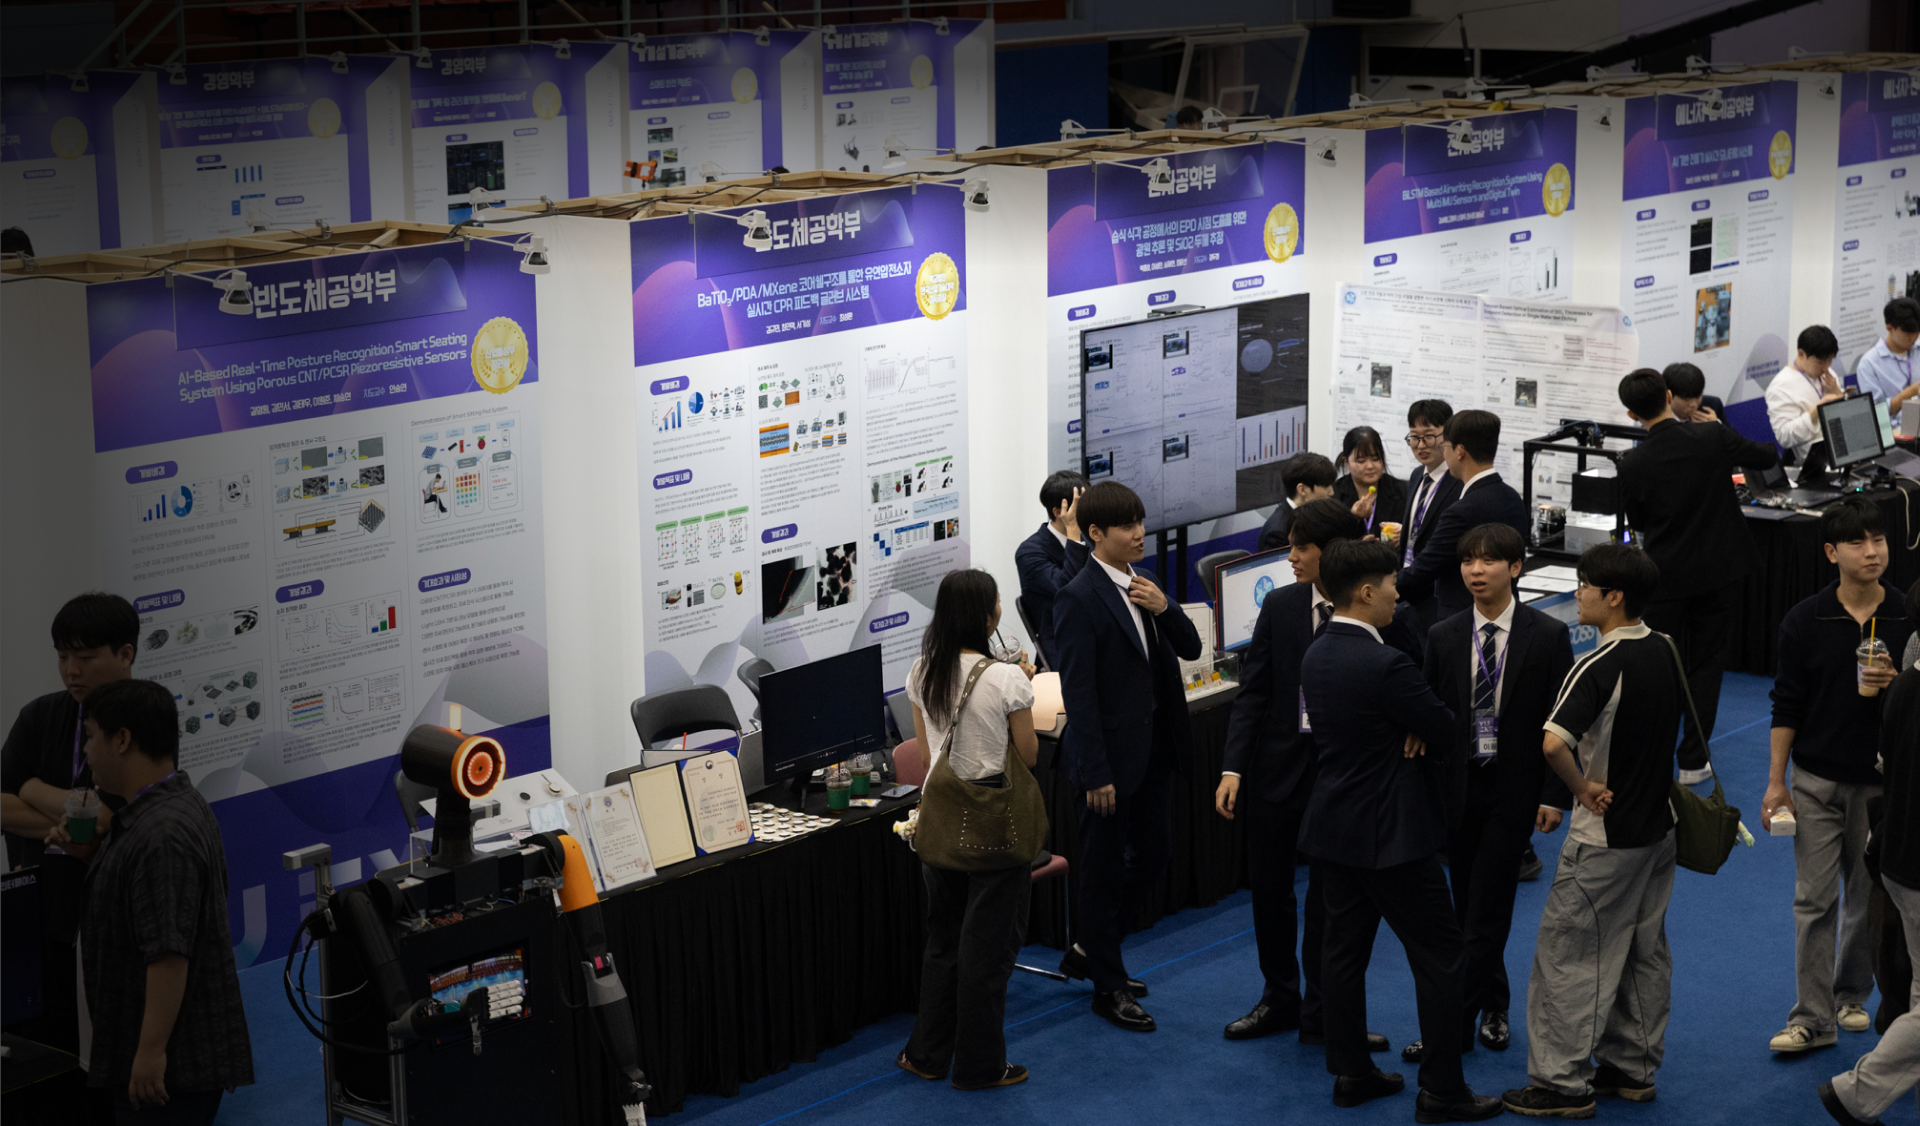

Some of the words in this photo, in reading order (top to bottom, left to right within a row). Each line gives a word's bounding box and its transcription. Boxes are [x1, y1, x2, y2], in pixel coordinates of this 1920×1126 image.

[441, 56, 486, 76] 경영학부
[203, 71, 255, 90] 경영학부
[650, 79, 665, 89] 스마트
[666, 78, 677, 88] 안전
[1148, 164, 1217, 198] 공학부
[1424, 186, 1442, 197] Based
[1443, 181, 1472, 194] Airwriting
[1472, 177, 1505, 190] Recognition
[1506, 174, 1527, 186] System
[1528, 172, 1542, 183] Using
[1454, 193, 1478, 206] Sensors
[1478, 191, 1488, 200] and
[1489, 188, 1507, 201] Digital
[1508, 186, 1520, 197] Twin
[1112, 229, 1126, 244] 습식
[1127, 227, 1141, 241] 식각
[1142, 220, 1178, 239] 공정에서의
[1180, 218, 1196, 233] EPD
[1198, 216, 1211, 230] 시점
[1233, 211, 1247, 225] 위한
[1136, 242, 1150, 258] 광원
[1152, 240, 1166, 255] 추론
[1167, 238, 1174, 252] 및
[1175, 236, 1194, 251] SiO2
[1195, 234, 1209, 248] 두께
[1210, 231, 1224, 246] 추정
[799, 272, 846, 292] 코어쉘구조를
[848, 268, 864, 284] 통한
[865, 261, 911, 281] 유연압전소자
[253, 269, 396, 319] 반도체공학부
[747, 302, 772, 318] 실시간
[774, 297, 793, 312] CPR
[795, 294, 819, 310] 피드백
[821, 290, 845, 306] 글러브
[846, 285, 869, 303] 시스템
[820, 316, 837, 325] 지도교수
[178, 366, 229, 385] AI-Based
[232, 360, 286, 377] Real-Time
[287, 354, 331, 367] Posture
[334, 344, 394, 361] Recognition
[395, 339, 427, 353] Smart
[429, 333, 467, 348] Seating
[180, 384, 224, 403] System
[226, 380, 256, 394] Using
[257, 374, 296, 390] Porous
[298, 364, 350, 383] CNT/PCSR
[351, 354, 423, 375] Piezoresistive
[425, 350, 467, 364] Sensors
[363, 387, 385, 398] 지도교수
[411, 416, 446, 426] Demonstration
[445, 575, 450, 584] 및
[276, 607, 284, 615] 소자
